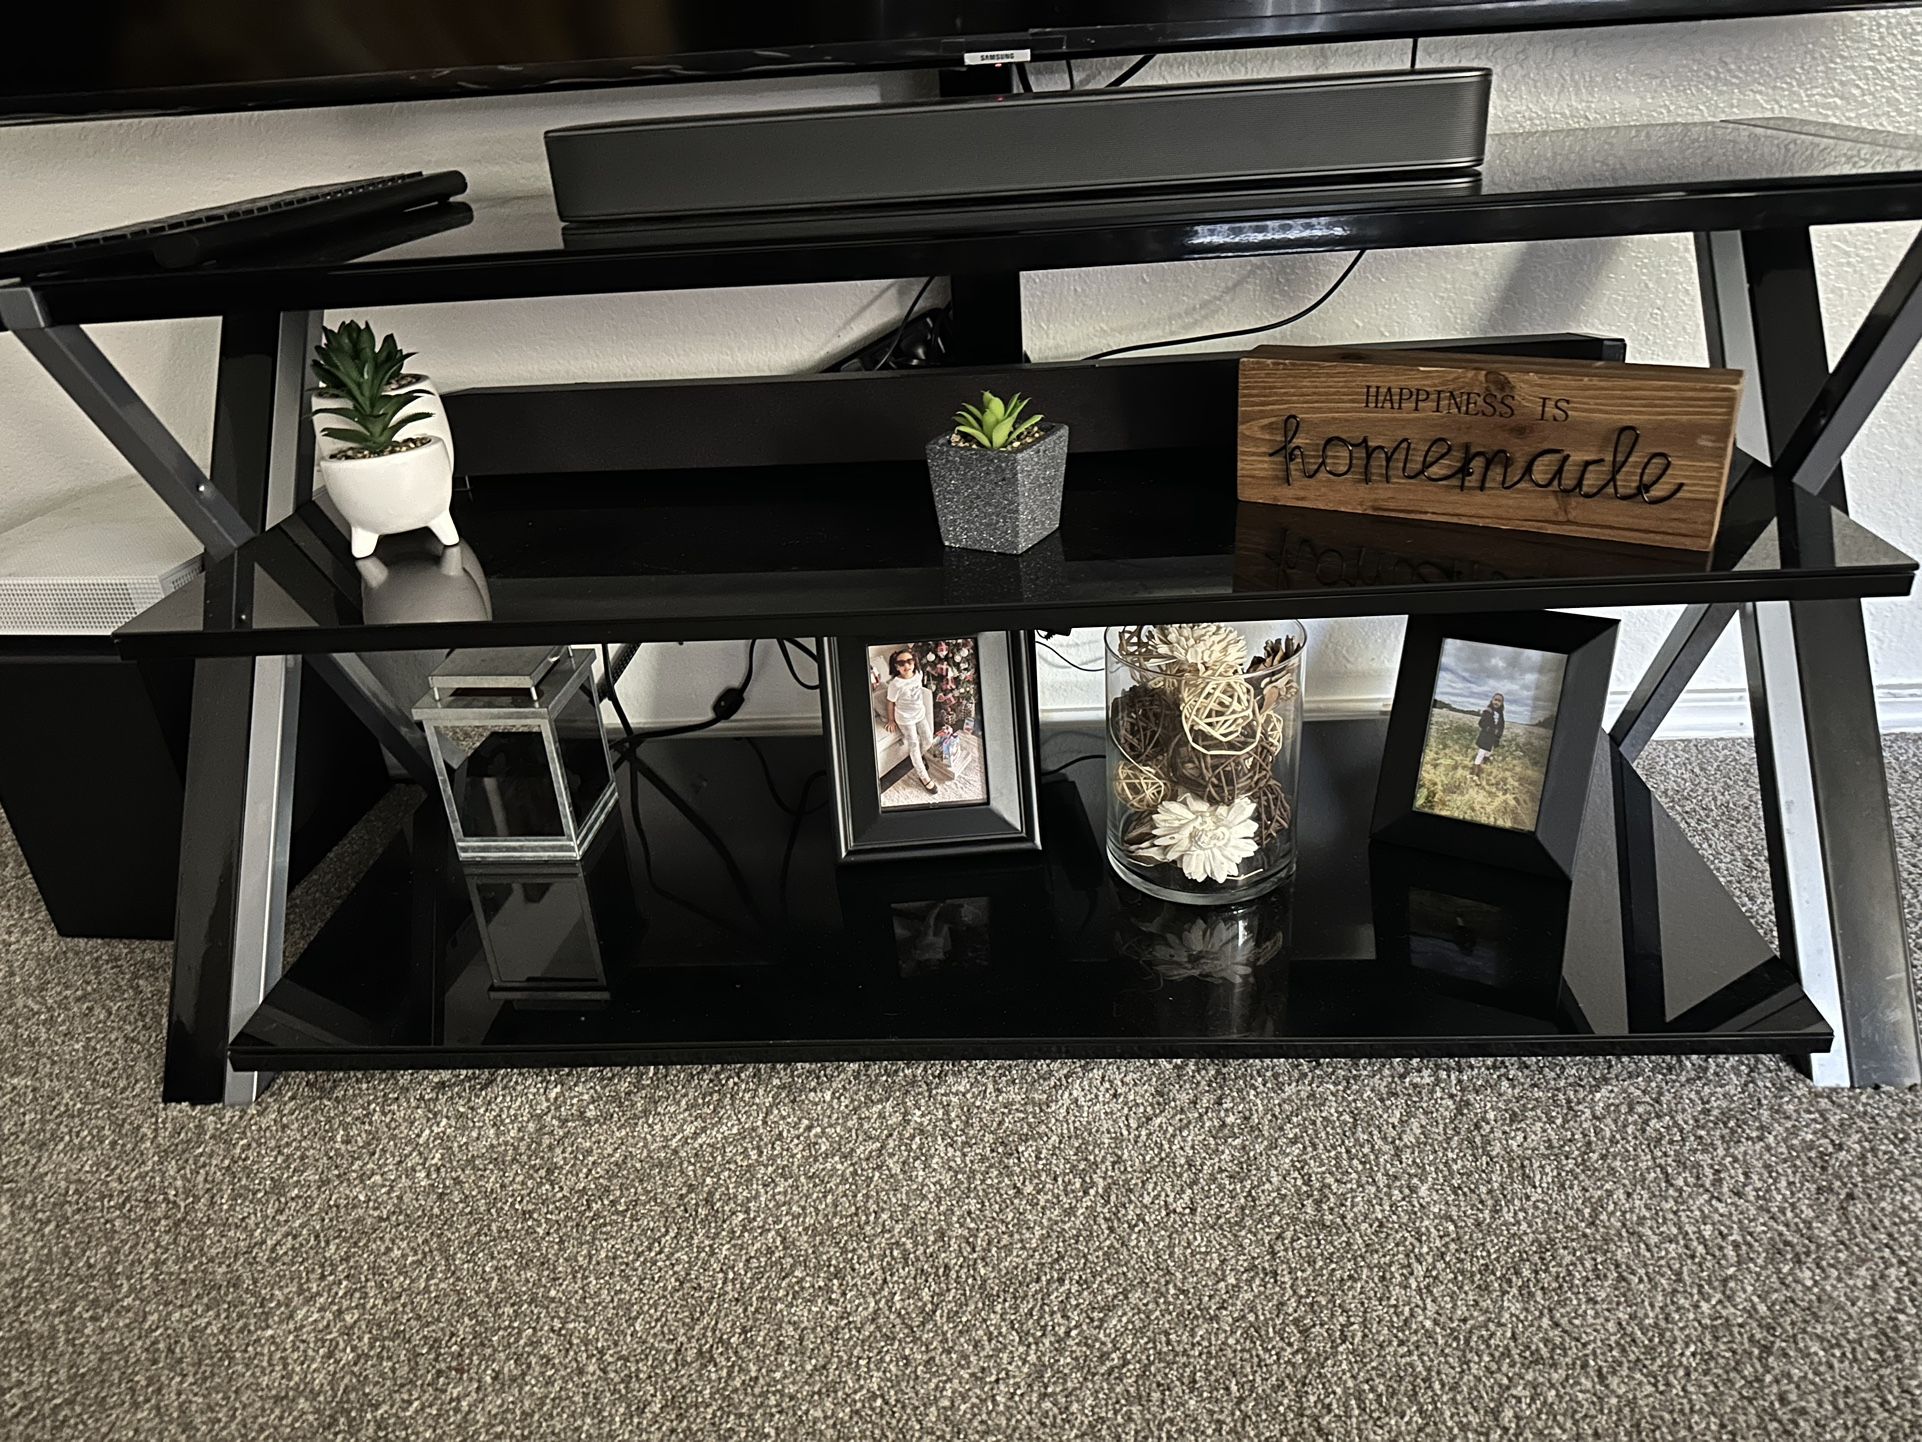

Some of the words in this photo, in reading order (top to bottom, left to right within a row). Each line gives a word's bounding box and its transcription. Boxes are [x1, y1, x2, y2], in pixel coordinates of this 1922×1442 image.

[980, 53, 1014, 61] SAMSUNG
[1364, 385, 1515, 418] HAPPINESS
[1536, 396, 1570, 422] IS
[1268, 414, 1684, 505] homemade
